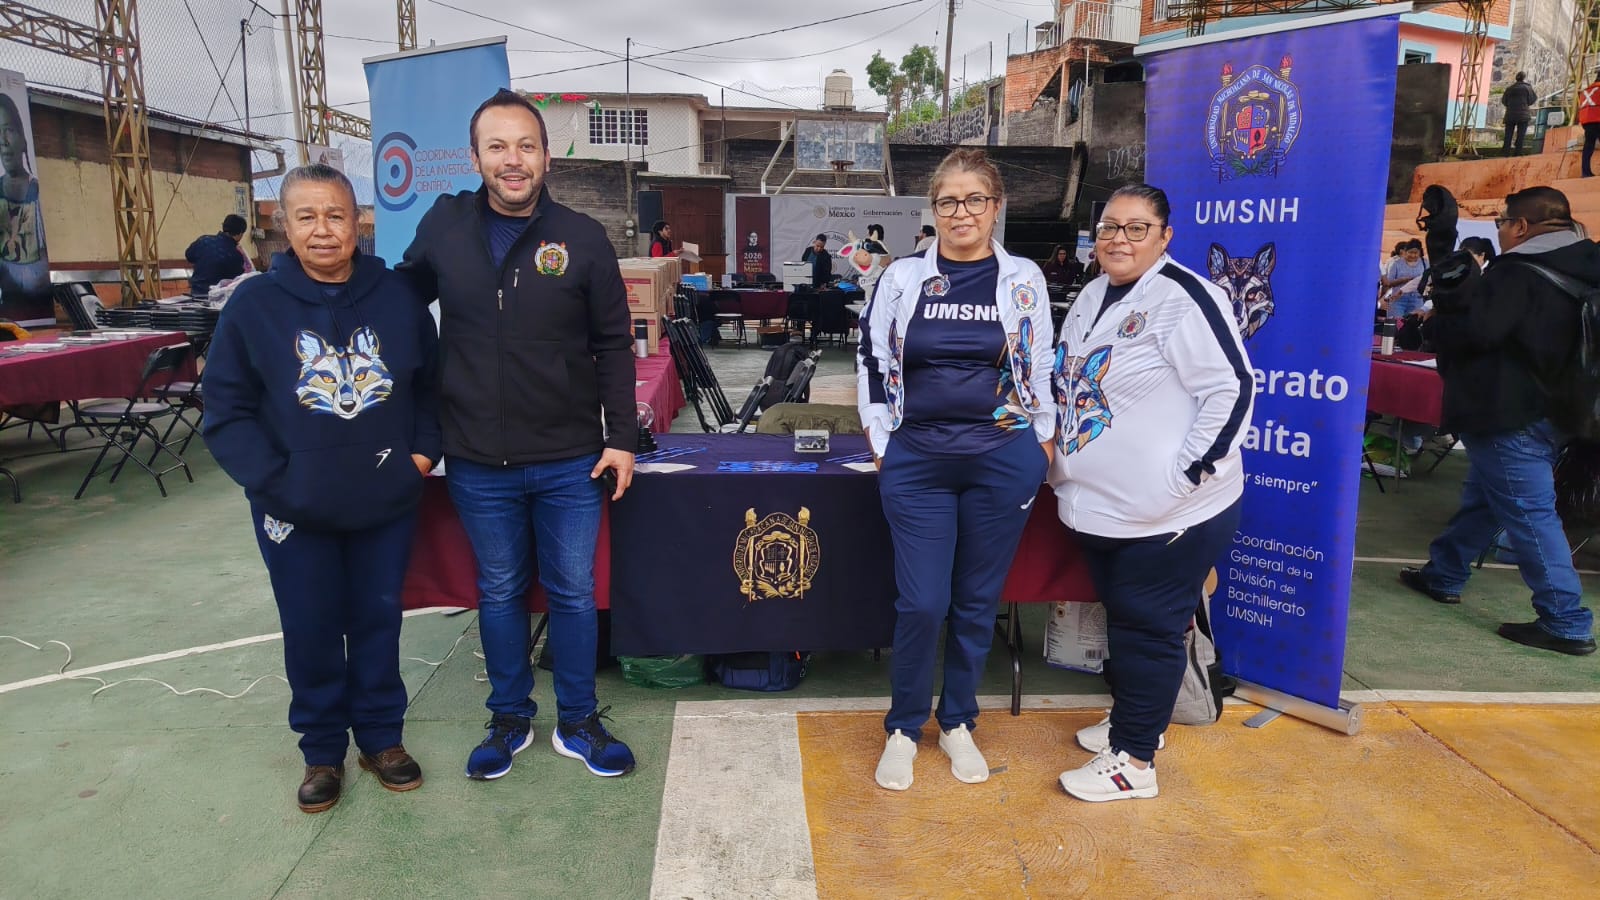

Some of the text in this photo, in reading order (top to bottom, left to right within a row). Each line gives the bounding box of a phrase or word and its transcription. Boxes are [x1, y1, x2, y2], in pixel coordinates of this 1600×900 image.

[1252, 69, 1261, 80] DE
[1261, 73, 1274, 86] SAN
[1287, 99, 1296, 111] DE
[1208, 105, 1220, 150] UNIVERSIDAD
[1284, 110, 1297, 144] HIDALGO
[414, 147, 472, 163] COORDINACI
[437, 163, 475, 176] INVESTIGA
[828, 209, 856, 218] México
[863, 208, 903, 217] Gobernación
[1195, 197, 1299, 225] UMSNH
[743, 252, 763, 260] 2026
[923, 303, 1001, 322] UMSNH
[1252, 367, 1349, 402] erato
[1242, 419, 1311, 458] aita
[1232, 530, 1324, 562] Coordinación
[1230, 549, 1313, 580] General de la
[1229, 567, 1296, 595] División del
[1228, 586, 1306, 617] Bachillerato
[1226, 603, 1273, 628] UMSNH
